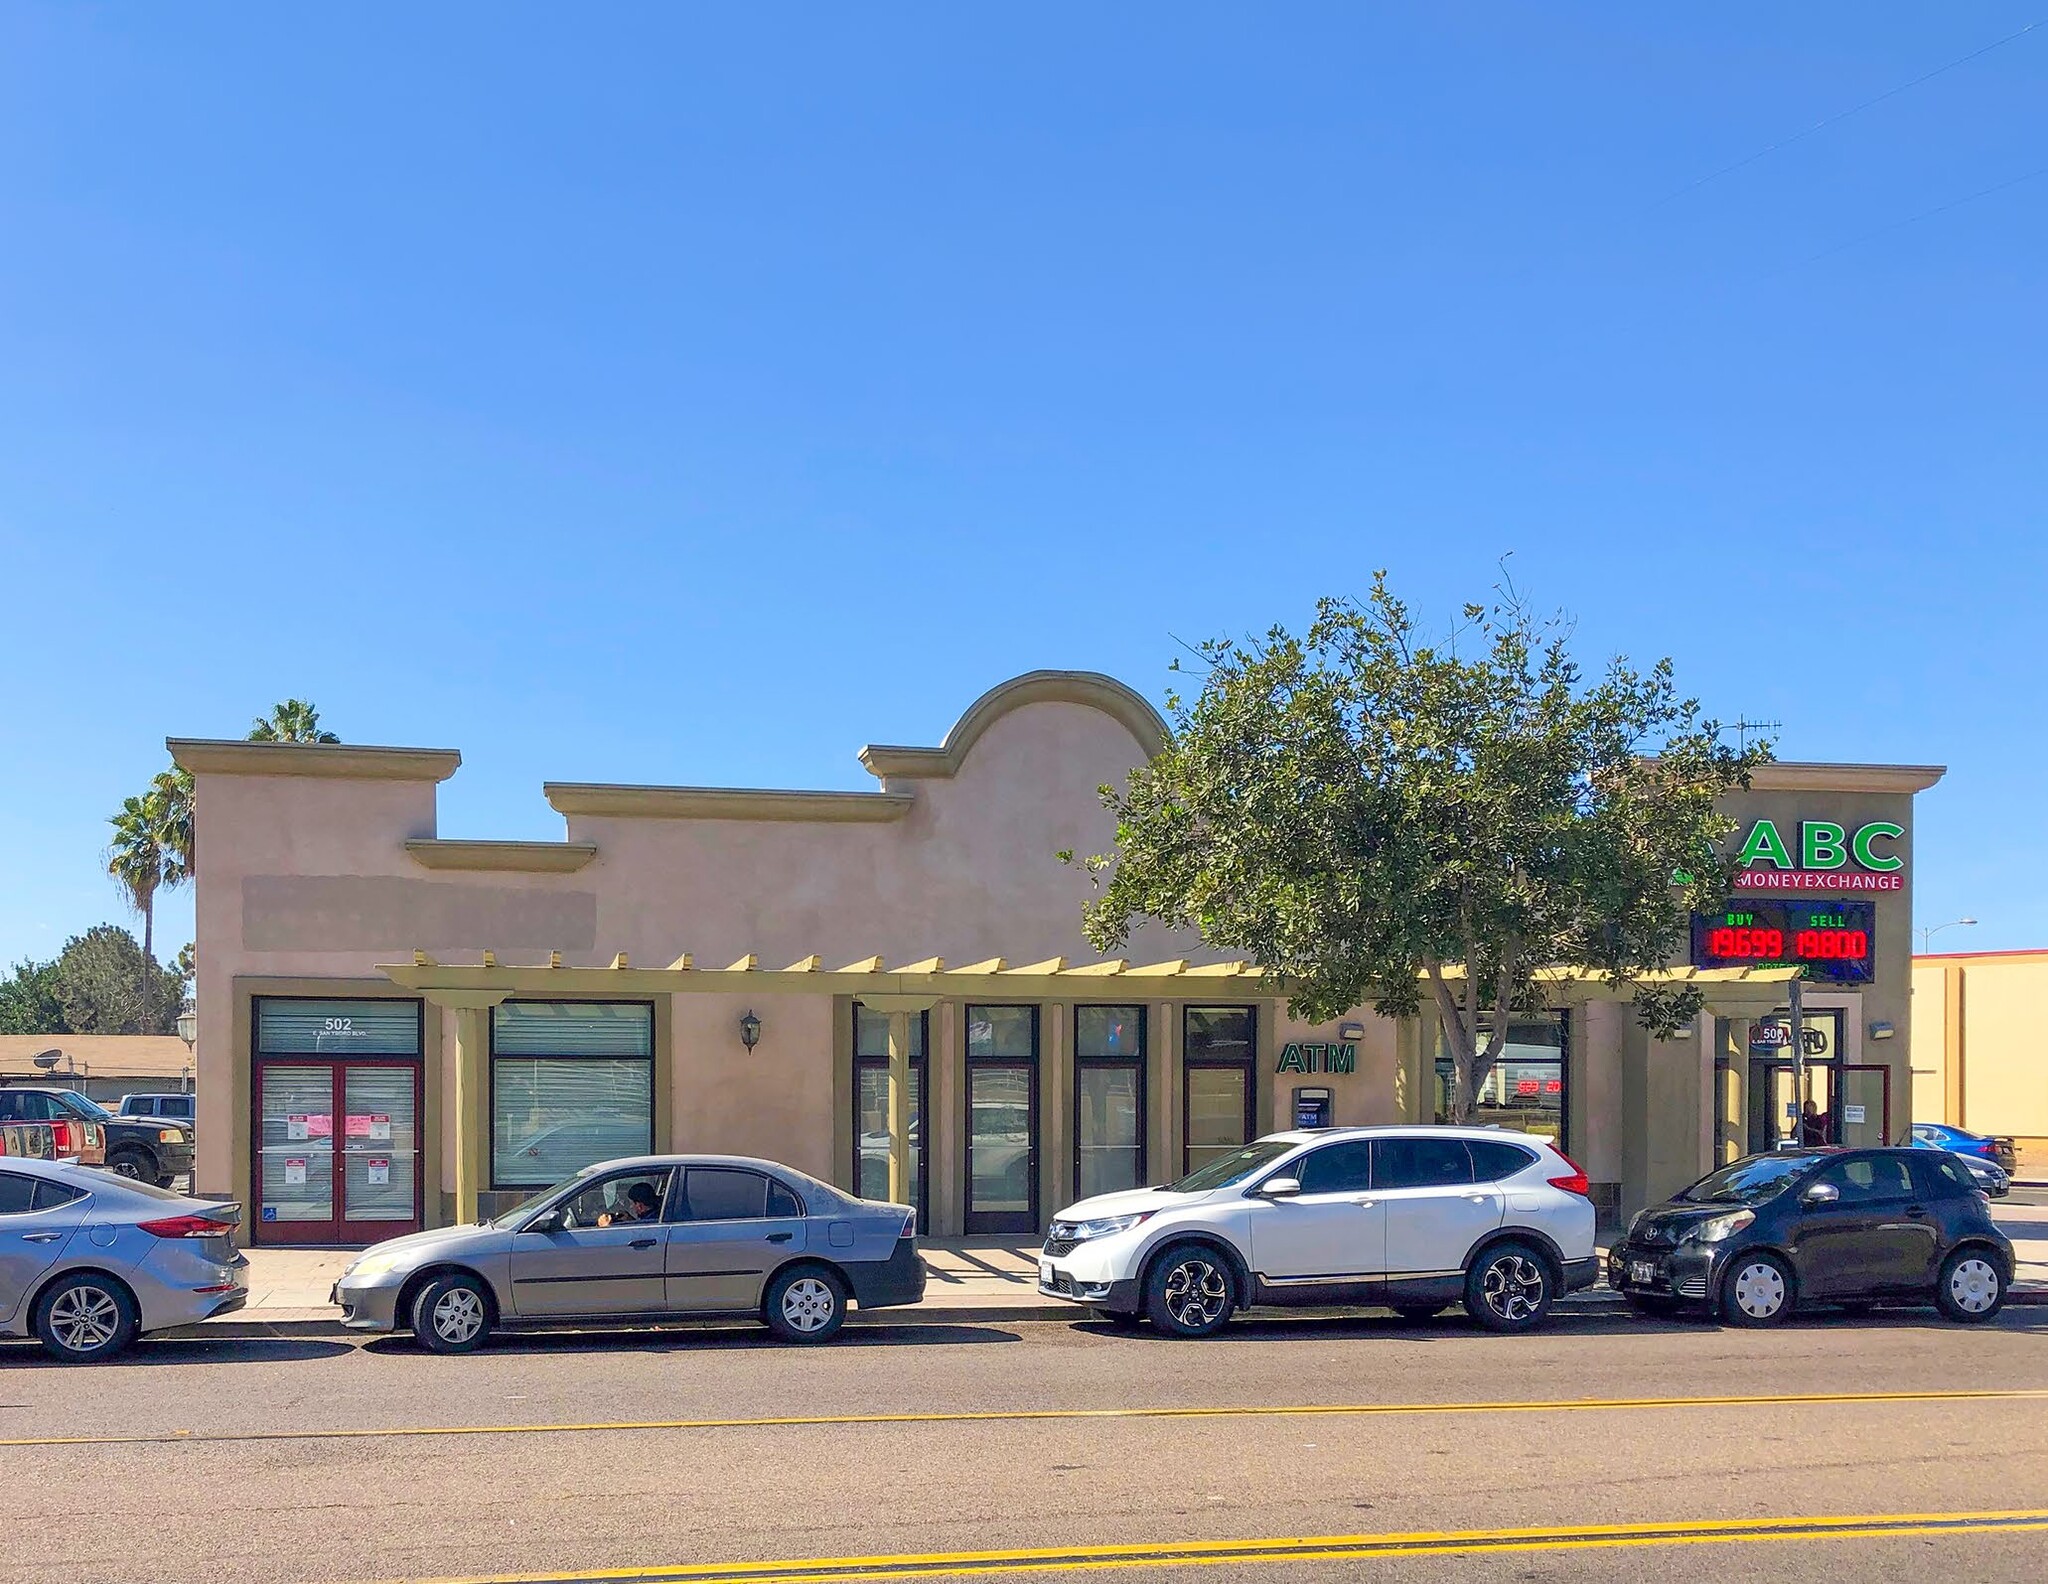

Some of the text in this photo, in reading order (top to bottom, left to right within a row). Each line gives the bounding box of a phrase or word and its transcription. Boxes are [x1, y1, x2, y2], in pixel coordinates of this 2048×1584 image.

[1736, 819, 1905, 872] ABC
[1727, 914, 1754, 926] BUY
[1810, 915, 1845, 927] SELL
[325, 1018, 352, 1031] 502
[1278, 1043, 1356, 1074] ATM
